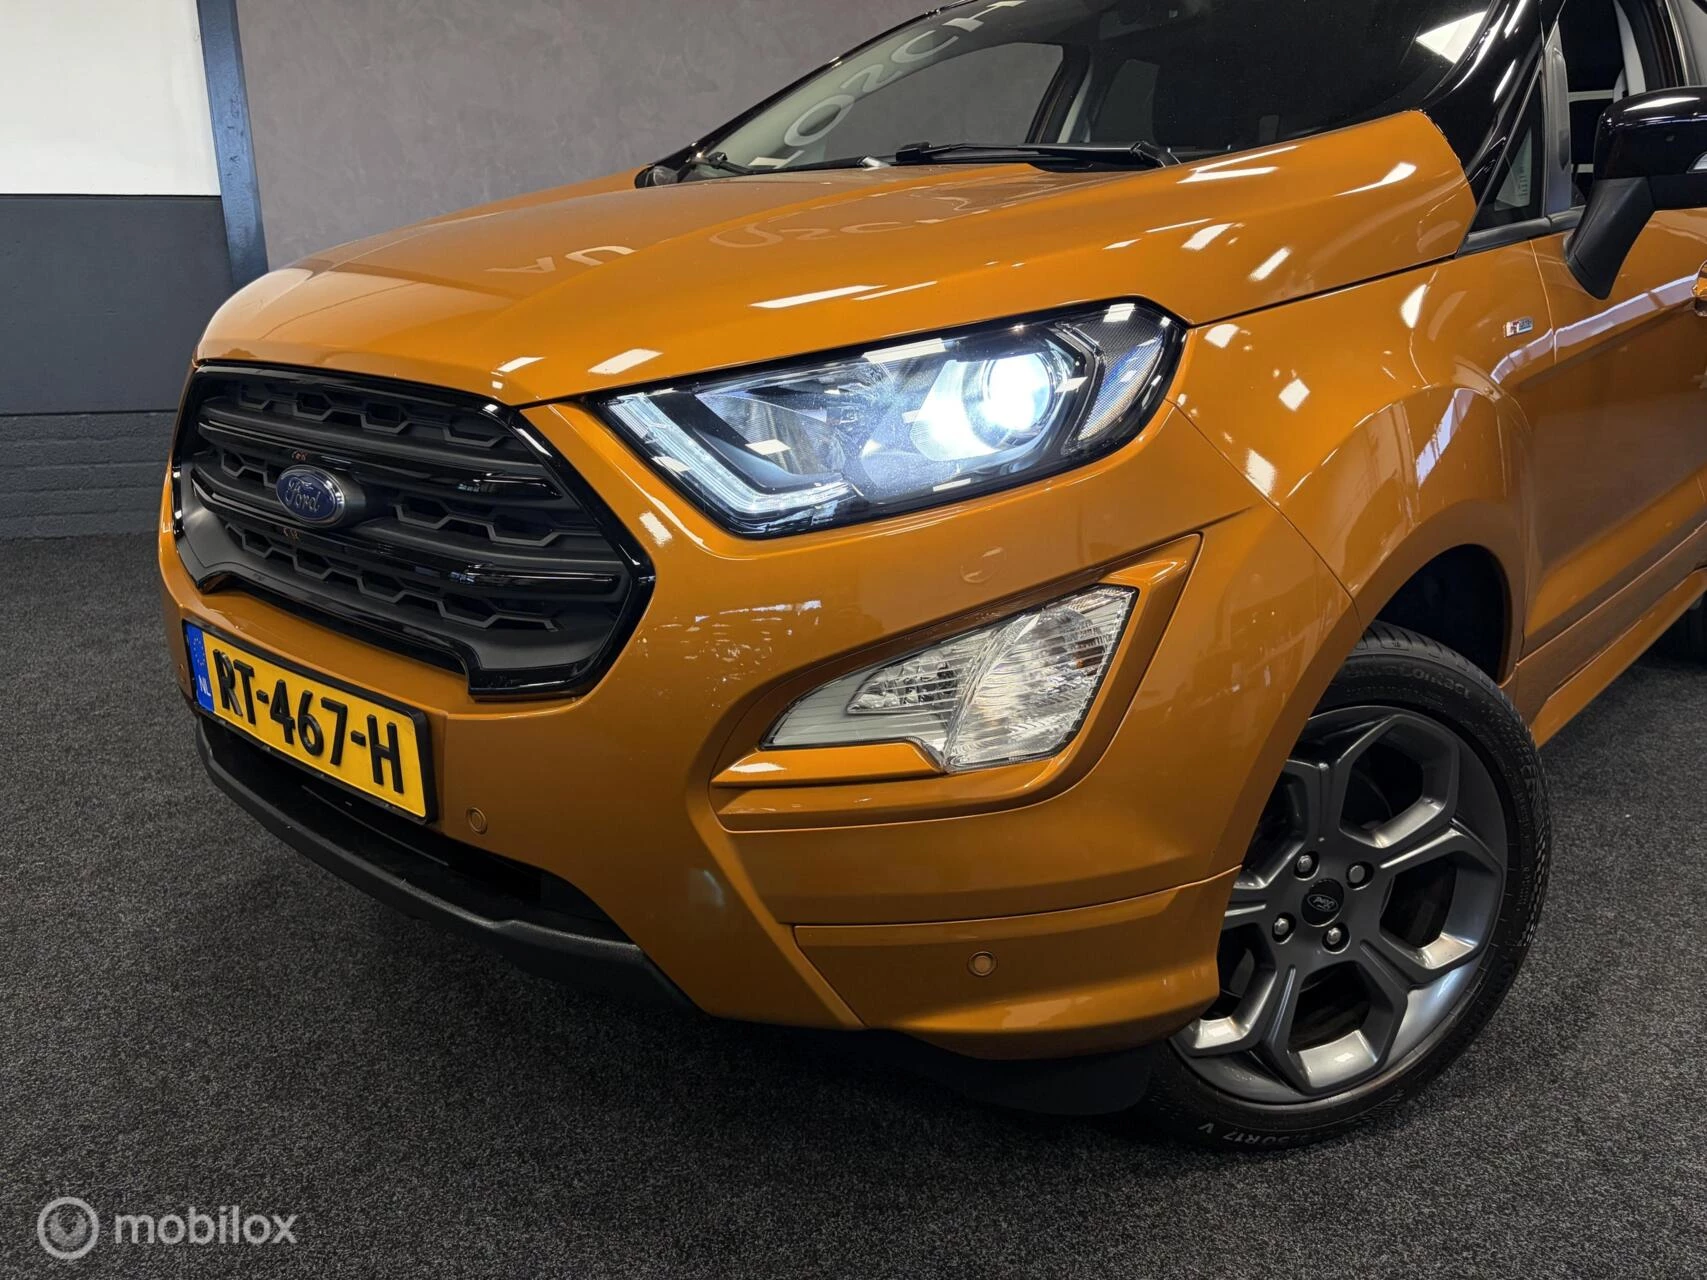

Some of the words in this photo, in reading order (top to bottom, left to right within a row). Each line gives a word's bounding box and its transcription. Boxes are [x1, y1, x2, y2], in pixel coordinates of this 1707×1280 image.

[285, 477, 321, 512] Ford
[198, 674, 212, 697] NL
[213, 649, 405, 794] RT-467-H
